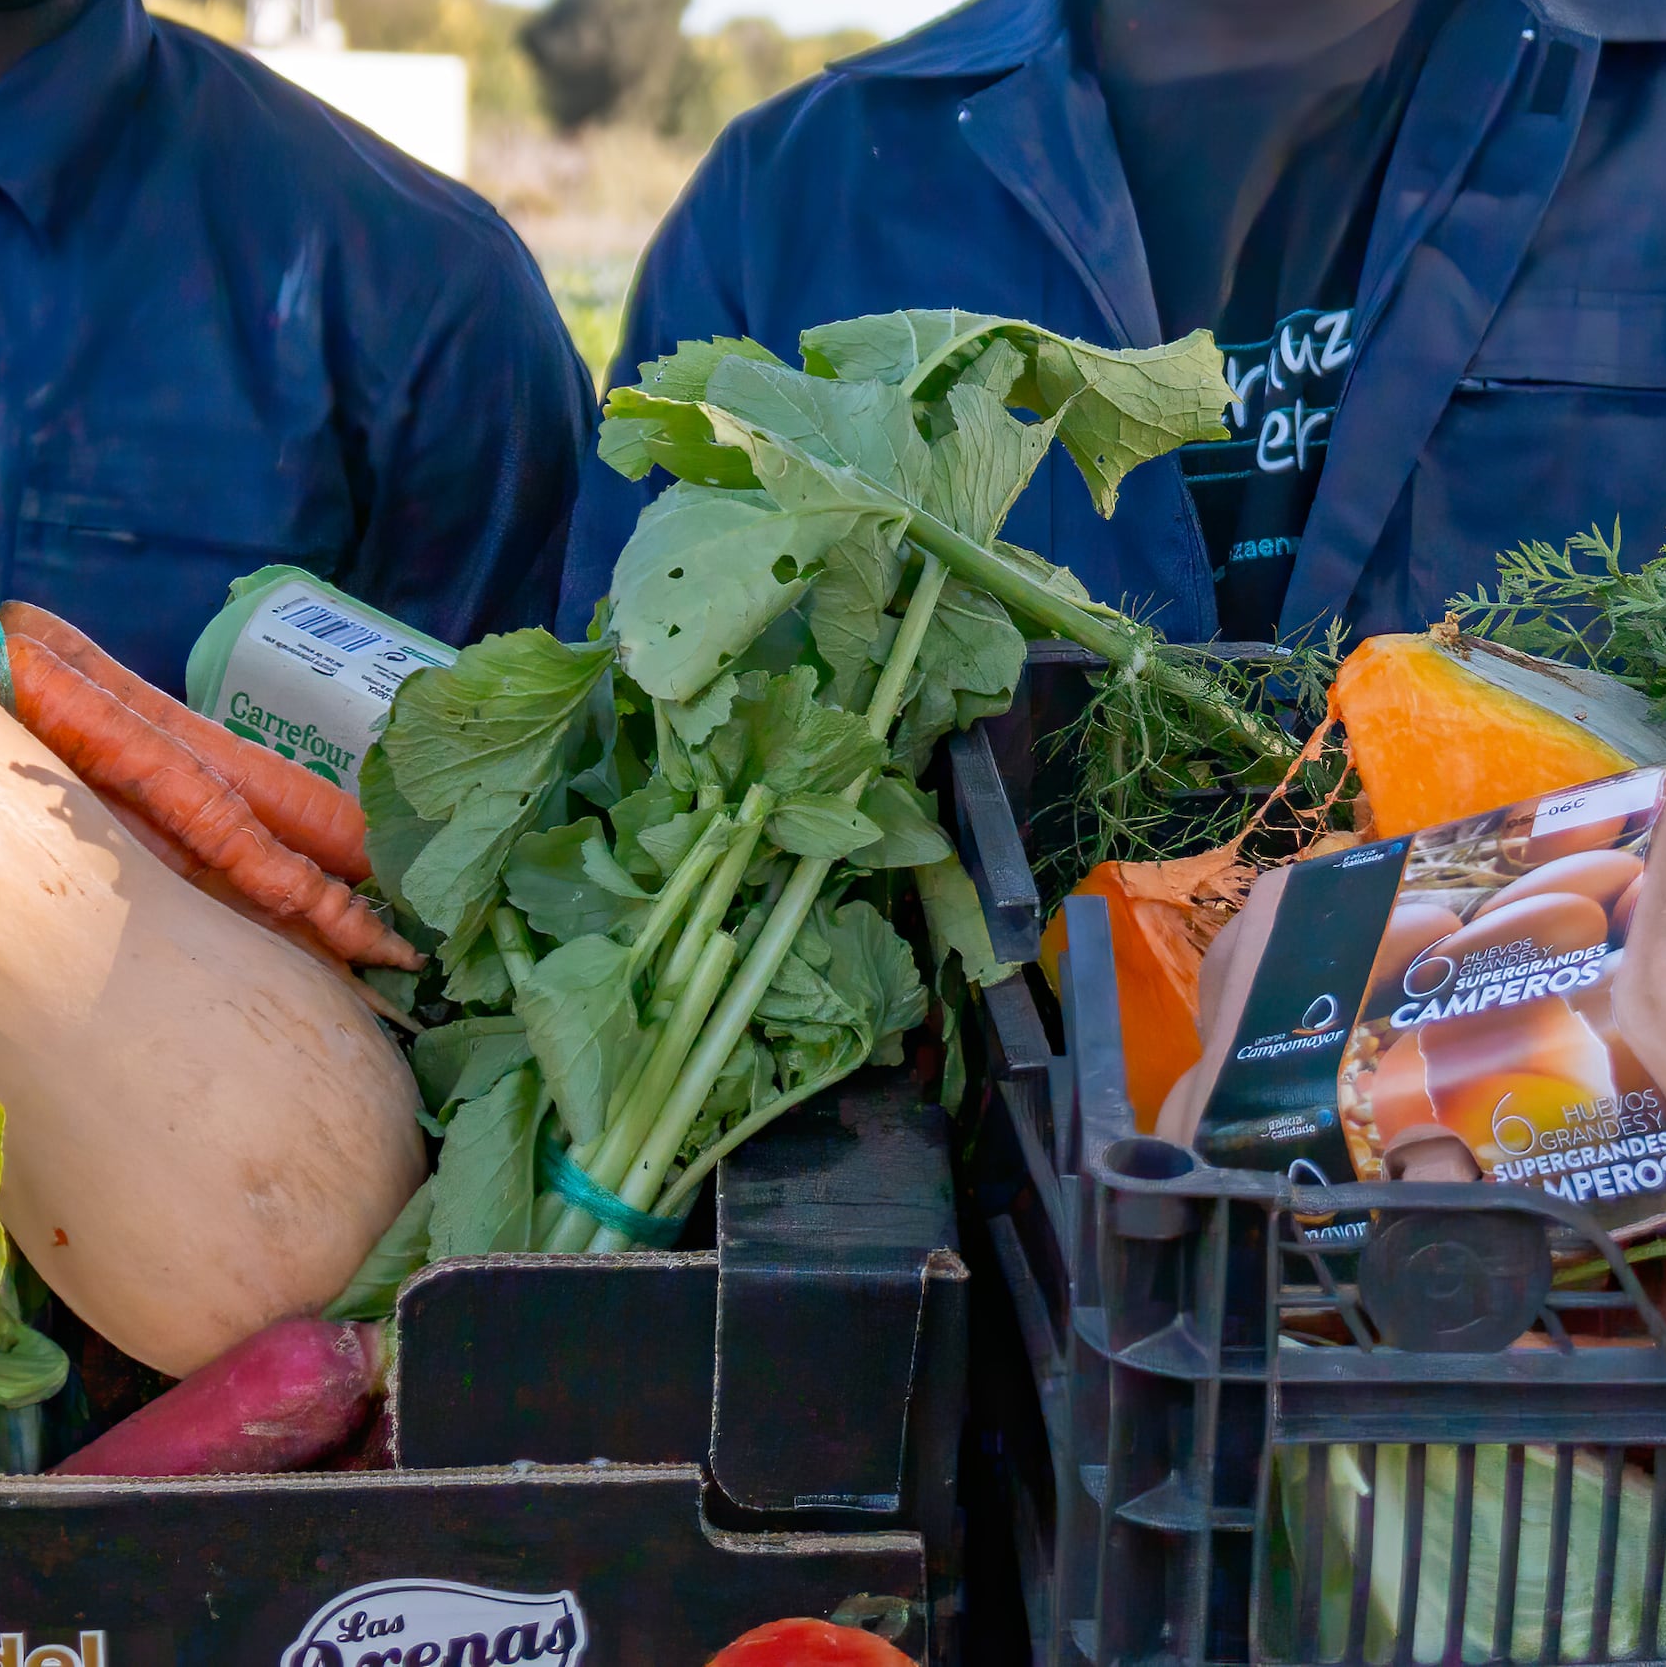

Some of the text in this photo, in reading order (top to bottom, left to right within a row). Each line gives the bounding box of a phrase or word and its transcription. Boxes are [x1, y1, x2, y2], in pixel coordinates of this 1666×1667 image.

[230, 691, 356, 772] Carrefour
[1403, 933, 1532, 997] 6 HUEVOS
[1454, 942, 1609, 991] SUPERGRANDES
[1458, 944, 1554, 977] GRANDES Y
[1389, 960, 1602, 1028] CAMPEROS
[1237, 1028, 1346, 1060] Campomayor
[1492, 1088, 1659, 1156] 6 HUEVOS
[1539, 1110, 1663, 1151] GRANDES Y
[336, 1610, 405, 1643] Las
